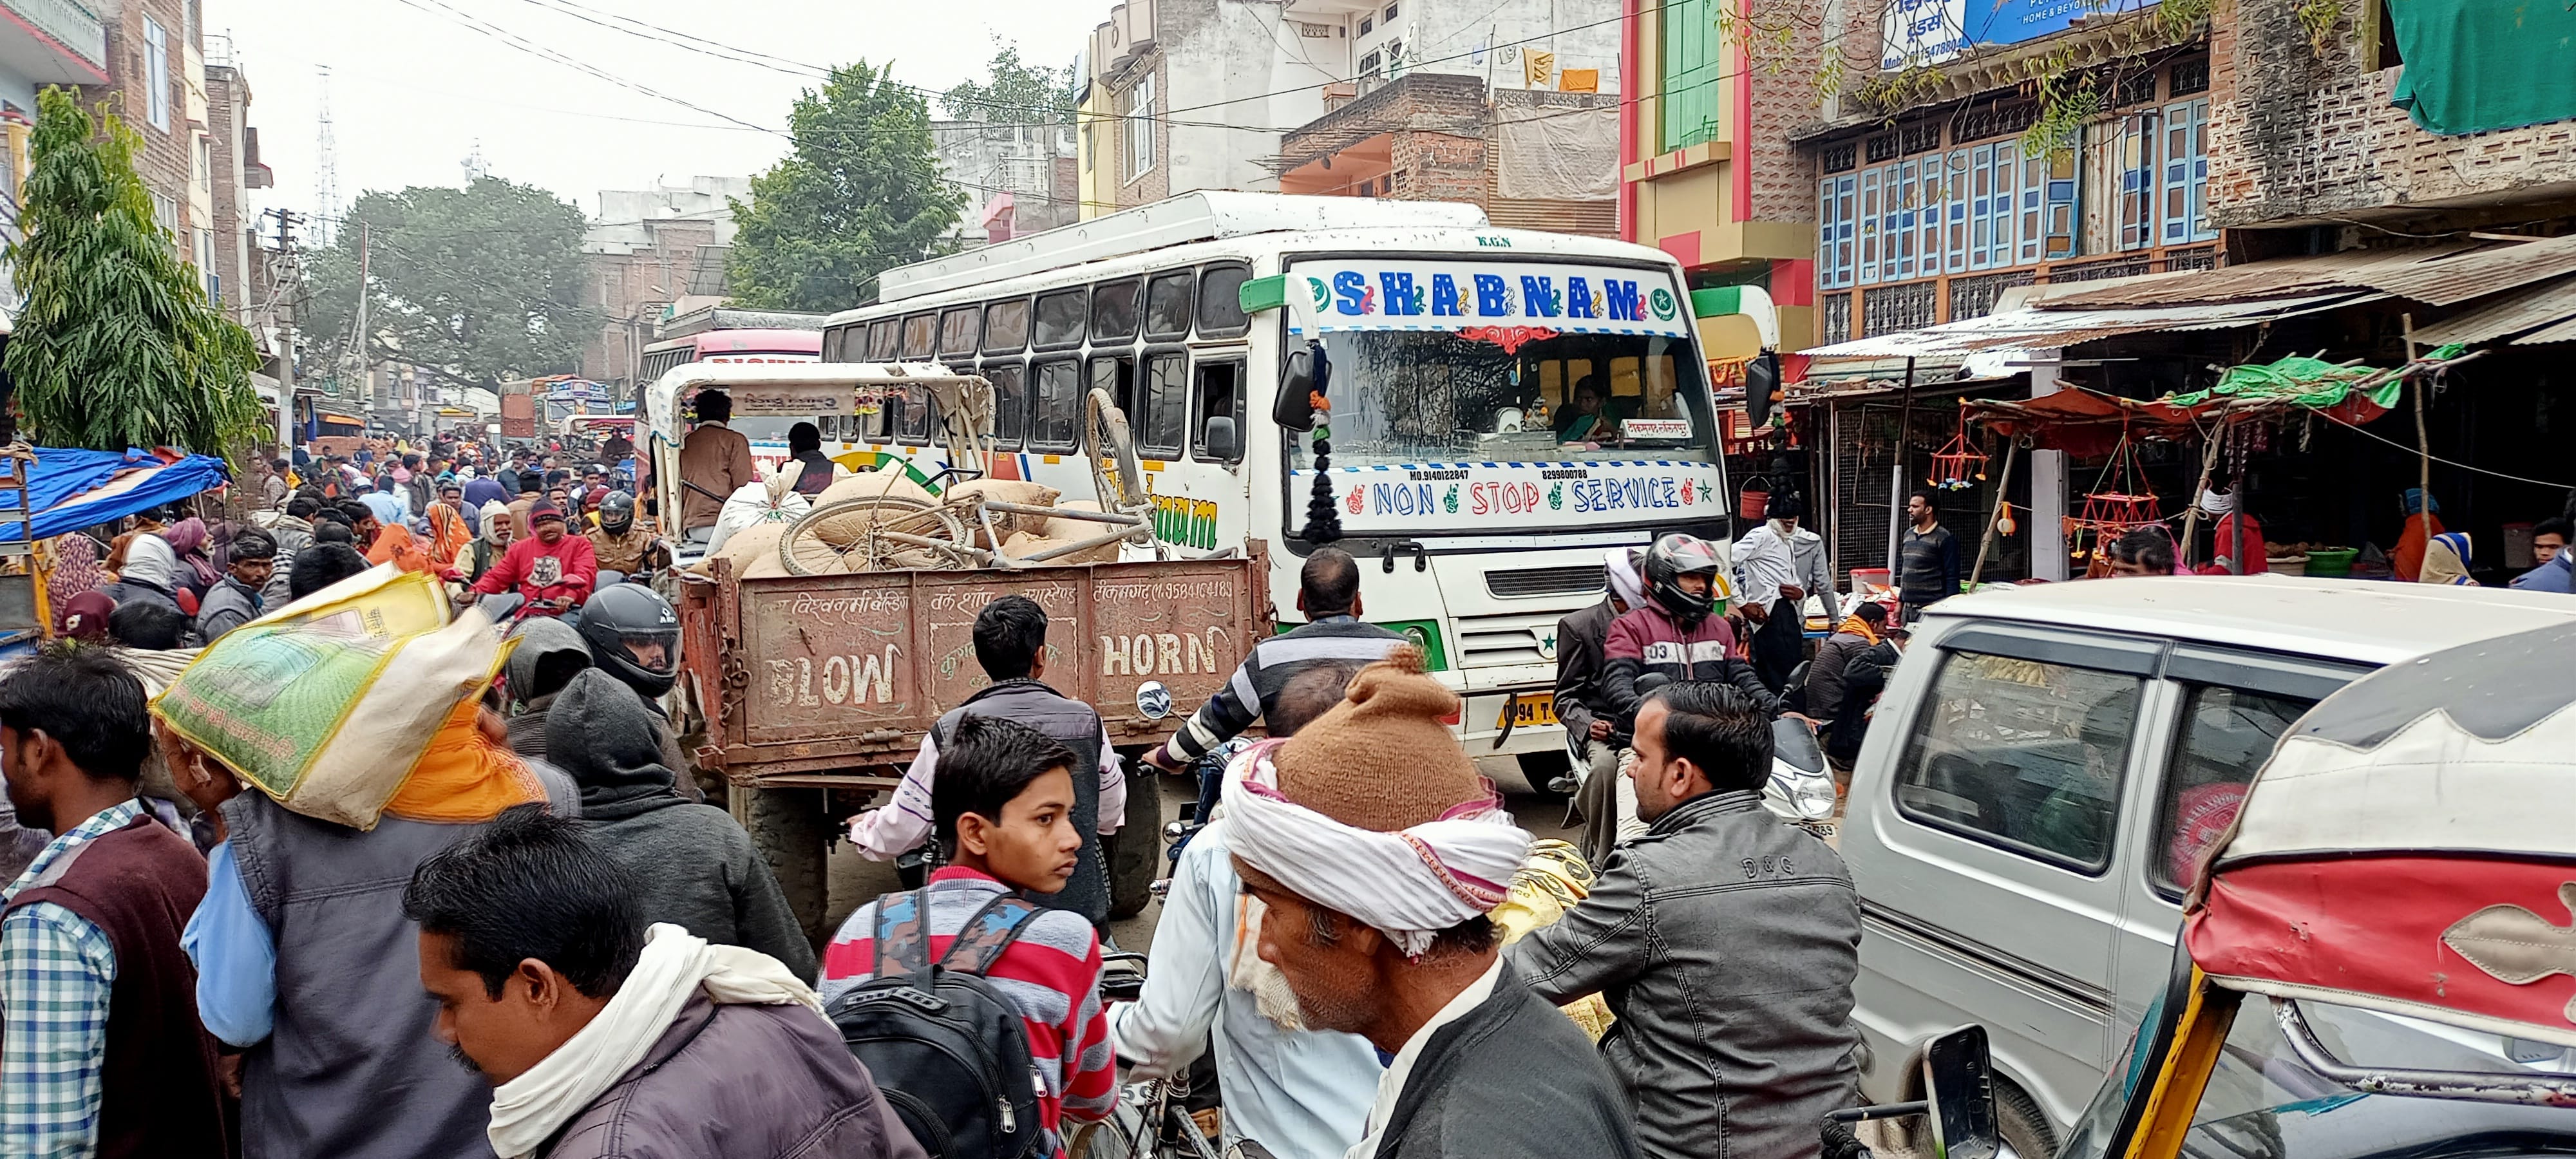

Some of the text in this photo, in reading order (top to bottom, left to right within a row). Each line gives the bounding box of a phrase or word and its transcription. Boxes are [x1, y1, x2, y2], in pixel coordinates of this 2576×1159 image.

[2022, 10, 2047, 24] HOME
[2049, 8, 2054, 17] &
[1333, 270, 1639, 321] SHABNAM
[1542, 469, 1587, 480] 8299800788
[1373, 477, 1680, 515] NON STOP SERVICE
[1649, 645, 1667, 659] 03
[765, 643, 903, 708] BLOW
[1099, 625, 1232, 675] HORN
